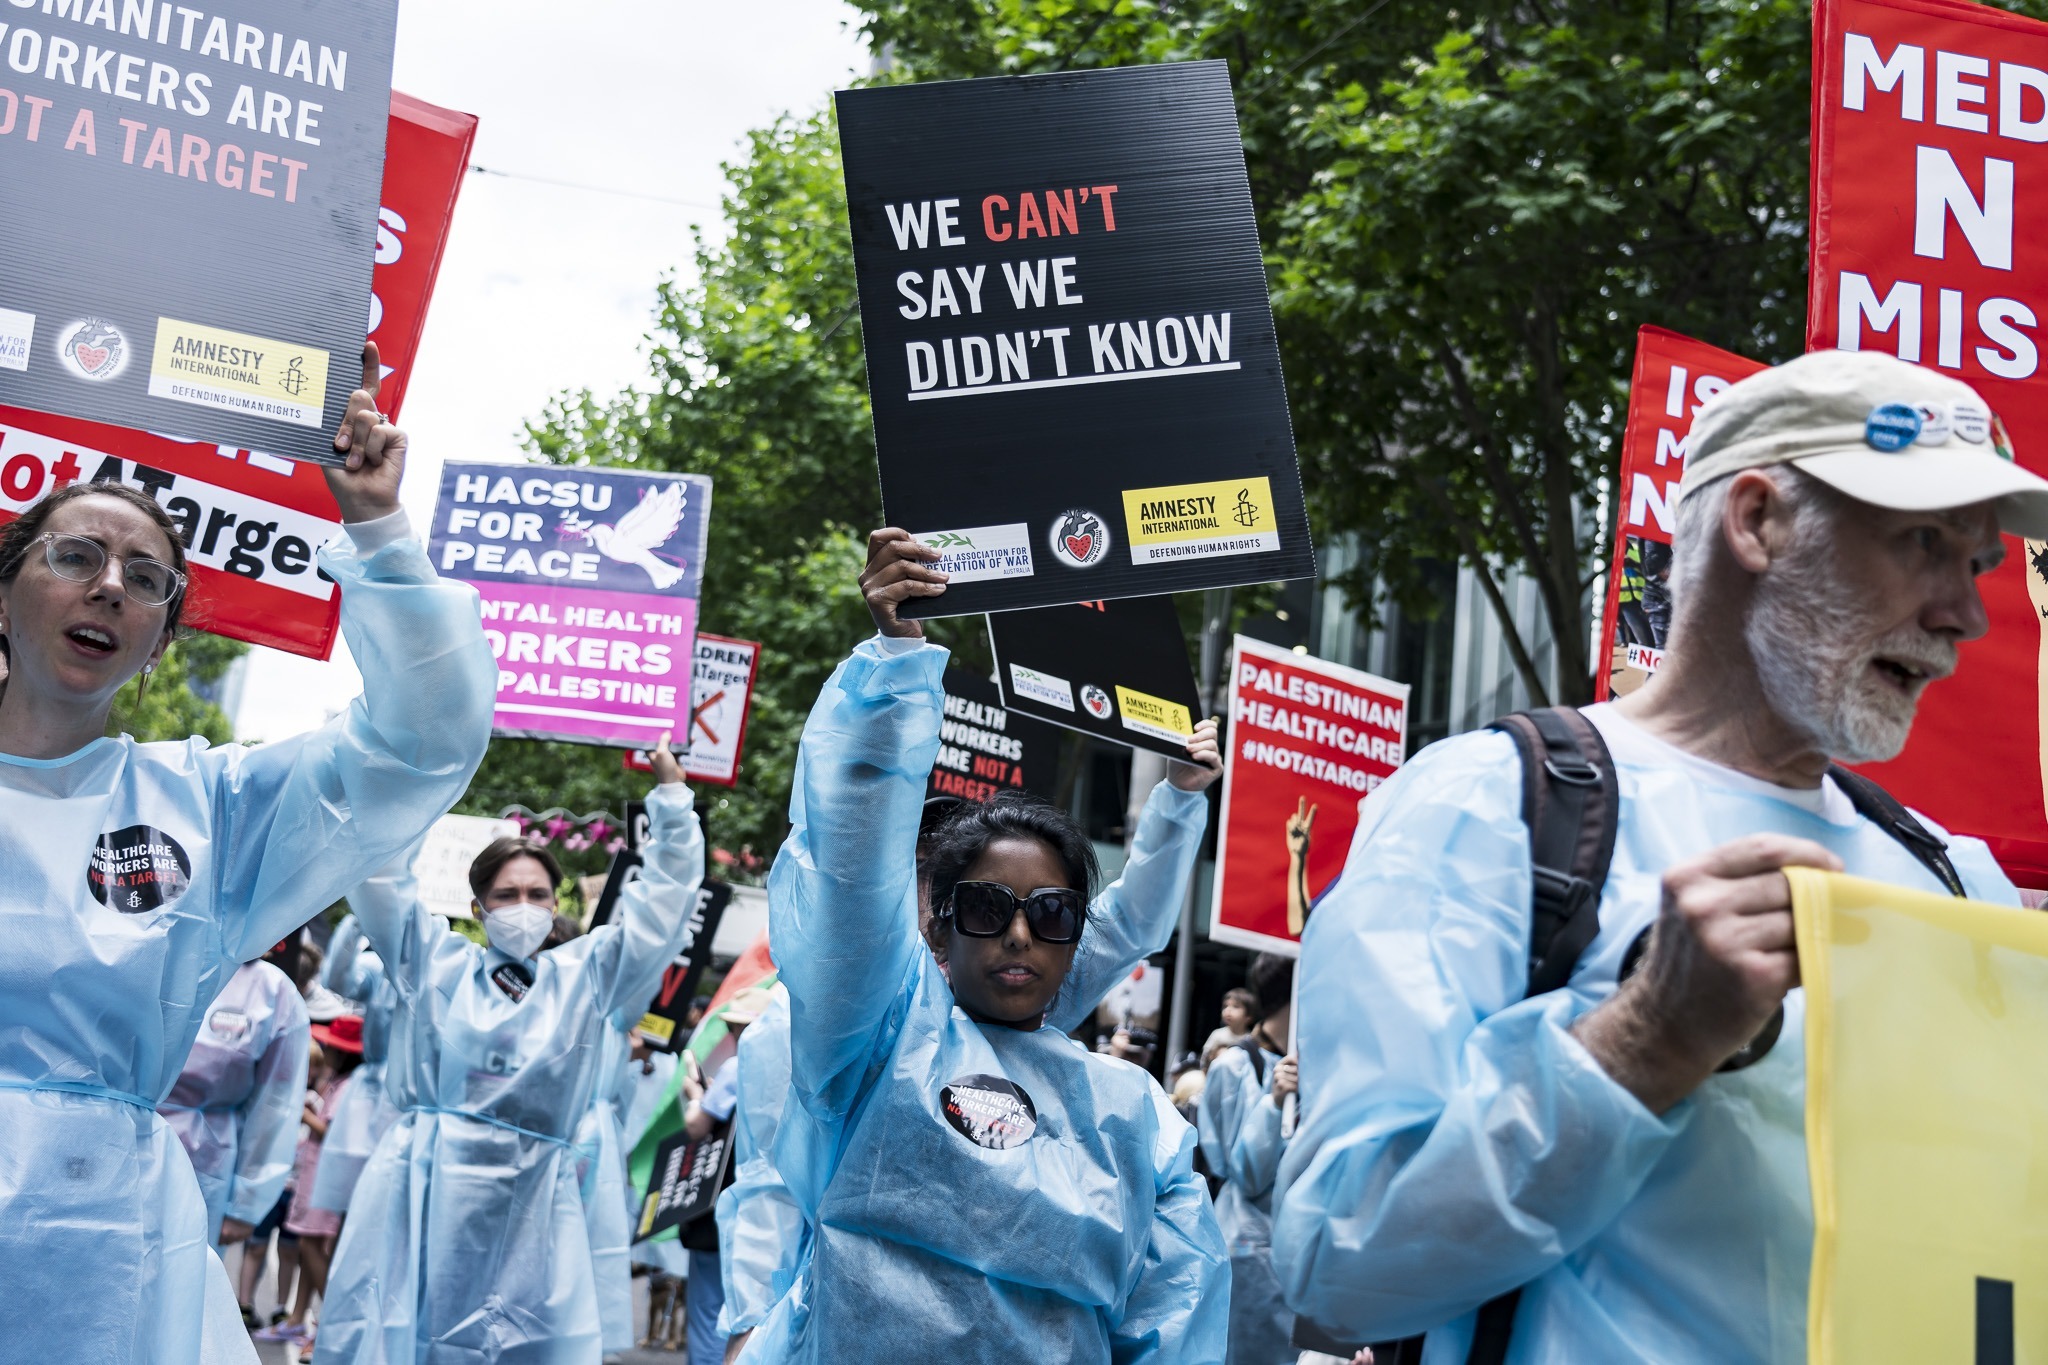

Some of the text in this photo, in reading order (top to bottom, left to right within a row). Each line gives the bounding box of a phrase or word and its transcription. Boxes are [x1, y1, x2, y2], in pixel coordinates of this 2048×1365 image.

[8, 0, 348, 92] ANITARIAN
[0, 22, 324, 147] ORKERS ARE
[64, 107, 97, 157] A
[118, 117, 309, 203] TARGET
[884, 184, 1119, 250] WE CAN'T
[897, 256, 1084, 320] SAY WE
[8, 336, 27, 347] FOR
[173, 336, 265, 370] AMNESTY
[905, 312, 1232, 391] DIDN'T KNOW
[170, 357, 261, 386] INTERNATIONAL
[172, 385, 301, 418] DEFENDING HUMAN RIGHTS
[454, 474, 613, 511] HACSU
[1140, 496, 1216, 520] AMNESTY
[447, 508, 545, 542] FOR
[1142, 517, 1220, 535] INTERNATIONAL
[441, 541, 601, 582] PEACE
[924, 555, 1029, 573] REVENTION OF WAR
[956, 548, 1009, 561] ASSOCIATION
[1012, 546, 1027, 556] FOR
[1090, 553, 1098, 563] FOR
[1150, 539, 1261, 558] DEFENDING HUMAN RIGHTS
[1003, 566, 1031, 575] AUSTRALIA
[564, 606, 683, 636] HEALTH
[497, 670, 678, 709] PALESTINE
[1126, 697, 1163, 715] AMNESTY
[1239, 661, 1402, 734] PALESTINIAN
[943, 694, 1007, 731] HEALTH
[940, 719, 1023, 761] WORKERS
[1235, 697, 1401, 768] HEALTHCARE
[935, 744, 1023, 788] ARE NOT A
[1242, 739, 1387, 794] #NOTATARGE
[933, 769, 998, 803] TARGET
[91, 857, 179, 875] WORKERS ARE
[94, 843, 173, 861] HEALTHCARE
[90, 869, 178, 887] NOT A TARGET
[950, 1093, 1026, 1128] WORKERS ARE
[958, 1085, 1027, 1115] HEALTHCARE
